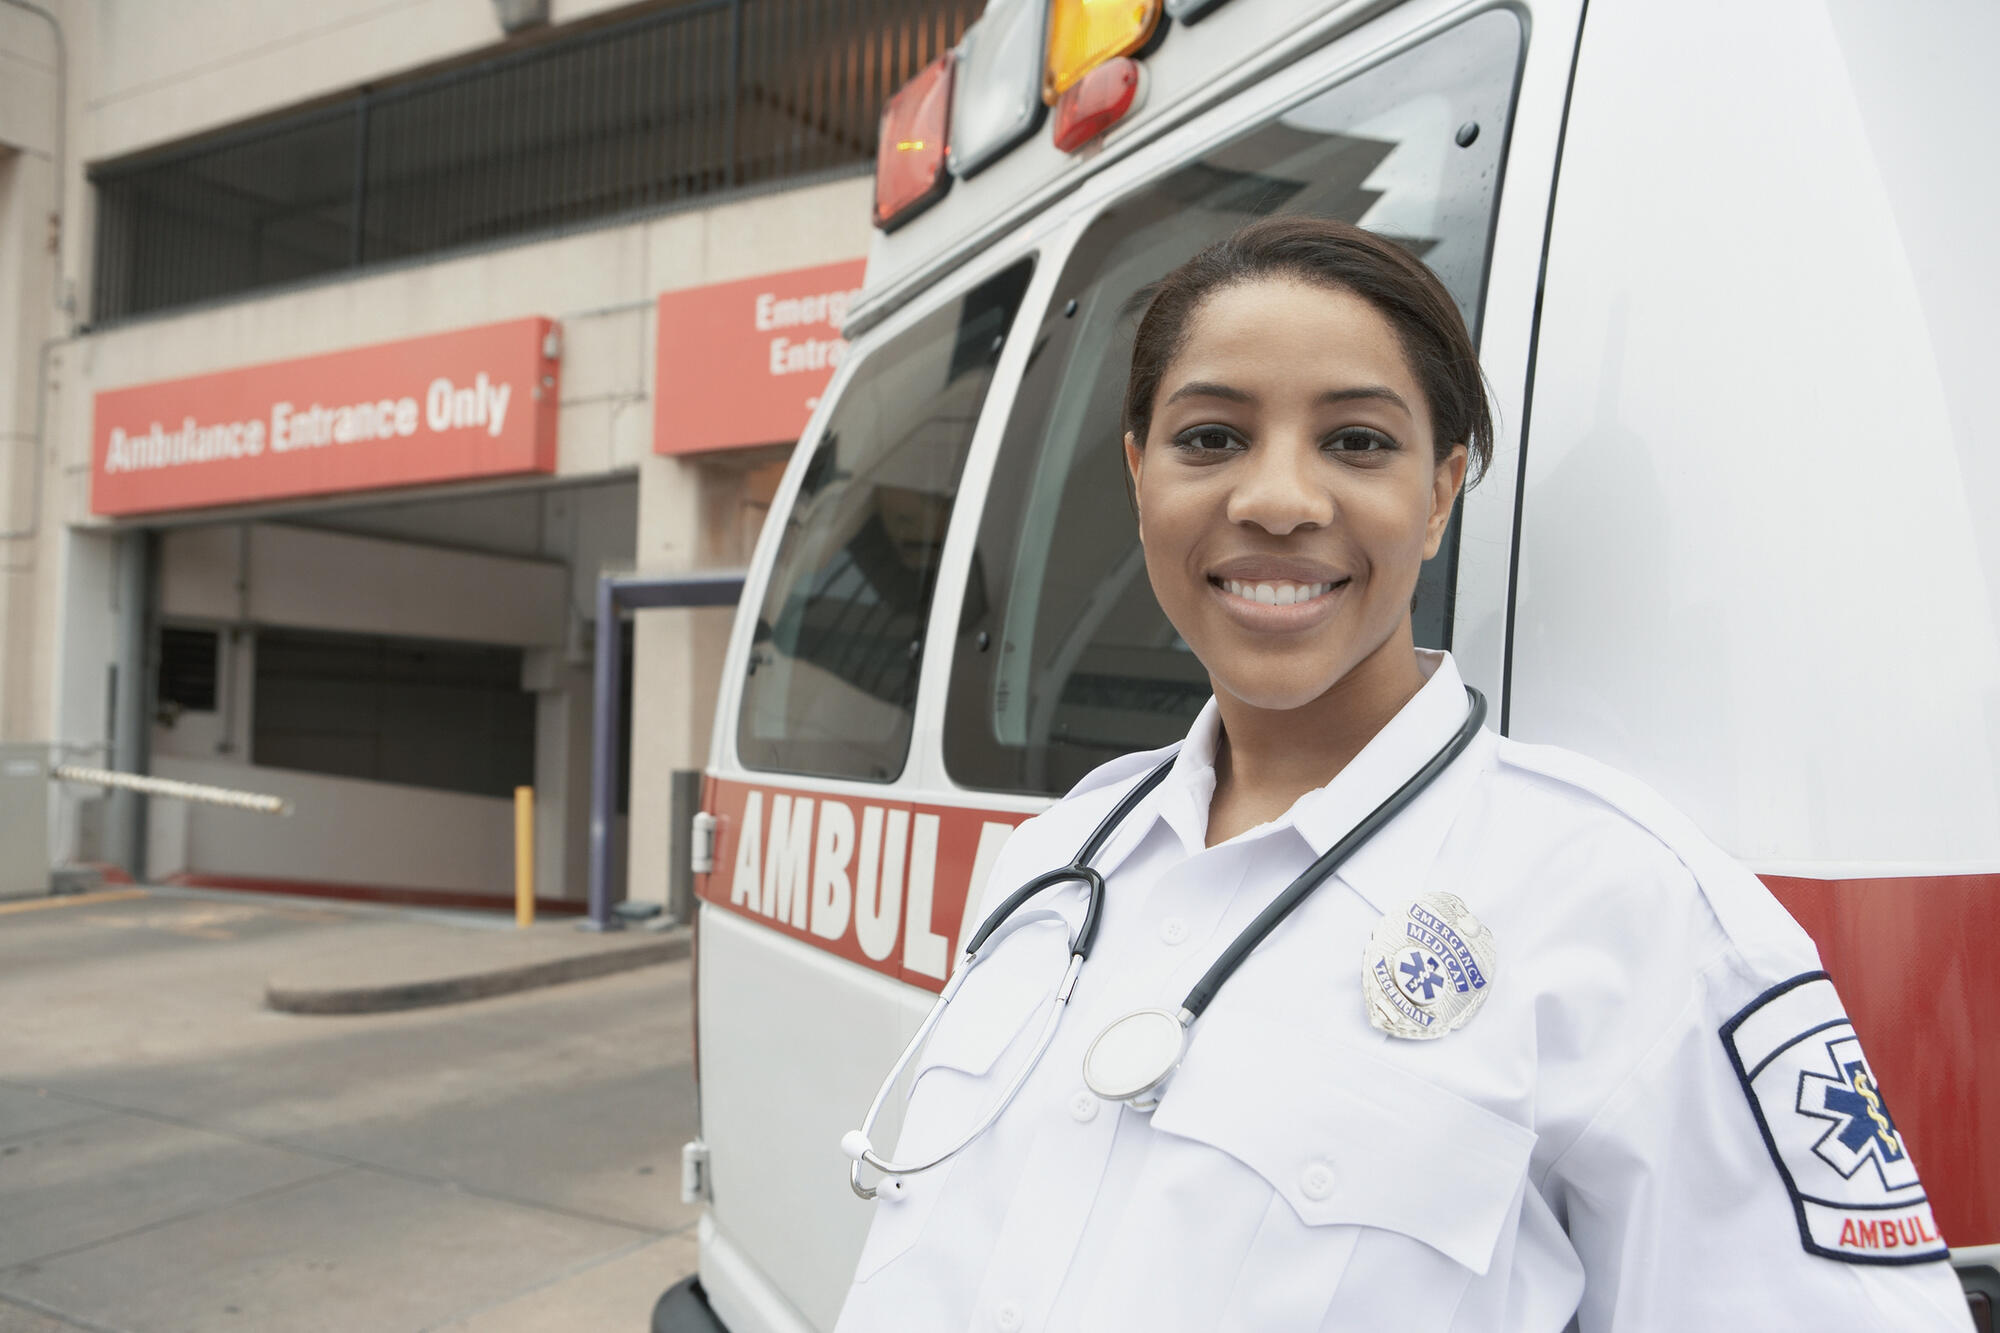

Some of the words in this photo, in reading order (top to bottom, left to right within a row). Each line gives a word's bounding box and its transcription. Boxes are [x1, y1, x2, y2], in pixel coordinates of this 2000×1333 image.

[105, 417, 266, 475] Ambulance
[271, 396, 419, 452] Entrance
[426, 371, 512, 437] Only
[1408, 925, 1466, 992] MEDICAL
[1411, 904, 1484, 988] EMERGENCY
[1374, 963, 1431, 1026] TECHNICIAN
[1839, 1216, 1941, 1249] AMBUL
